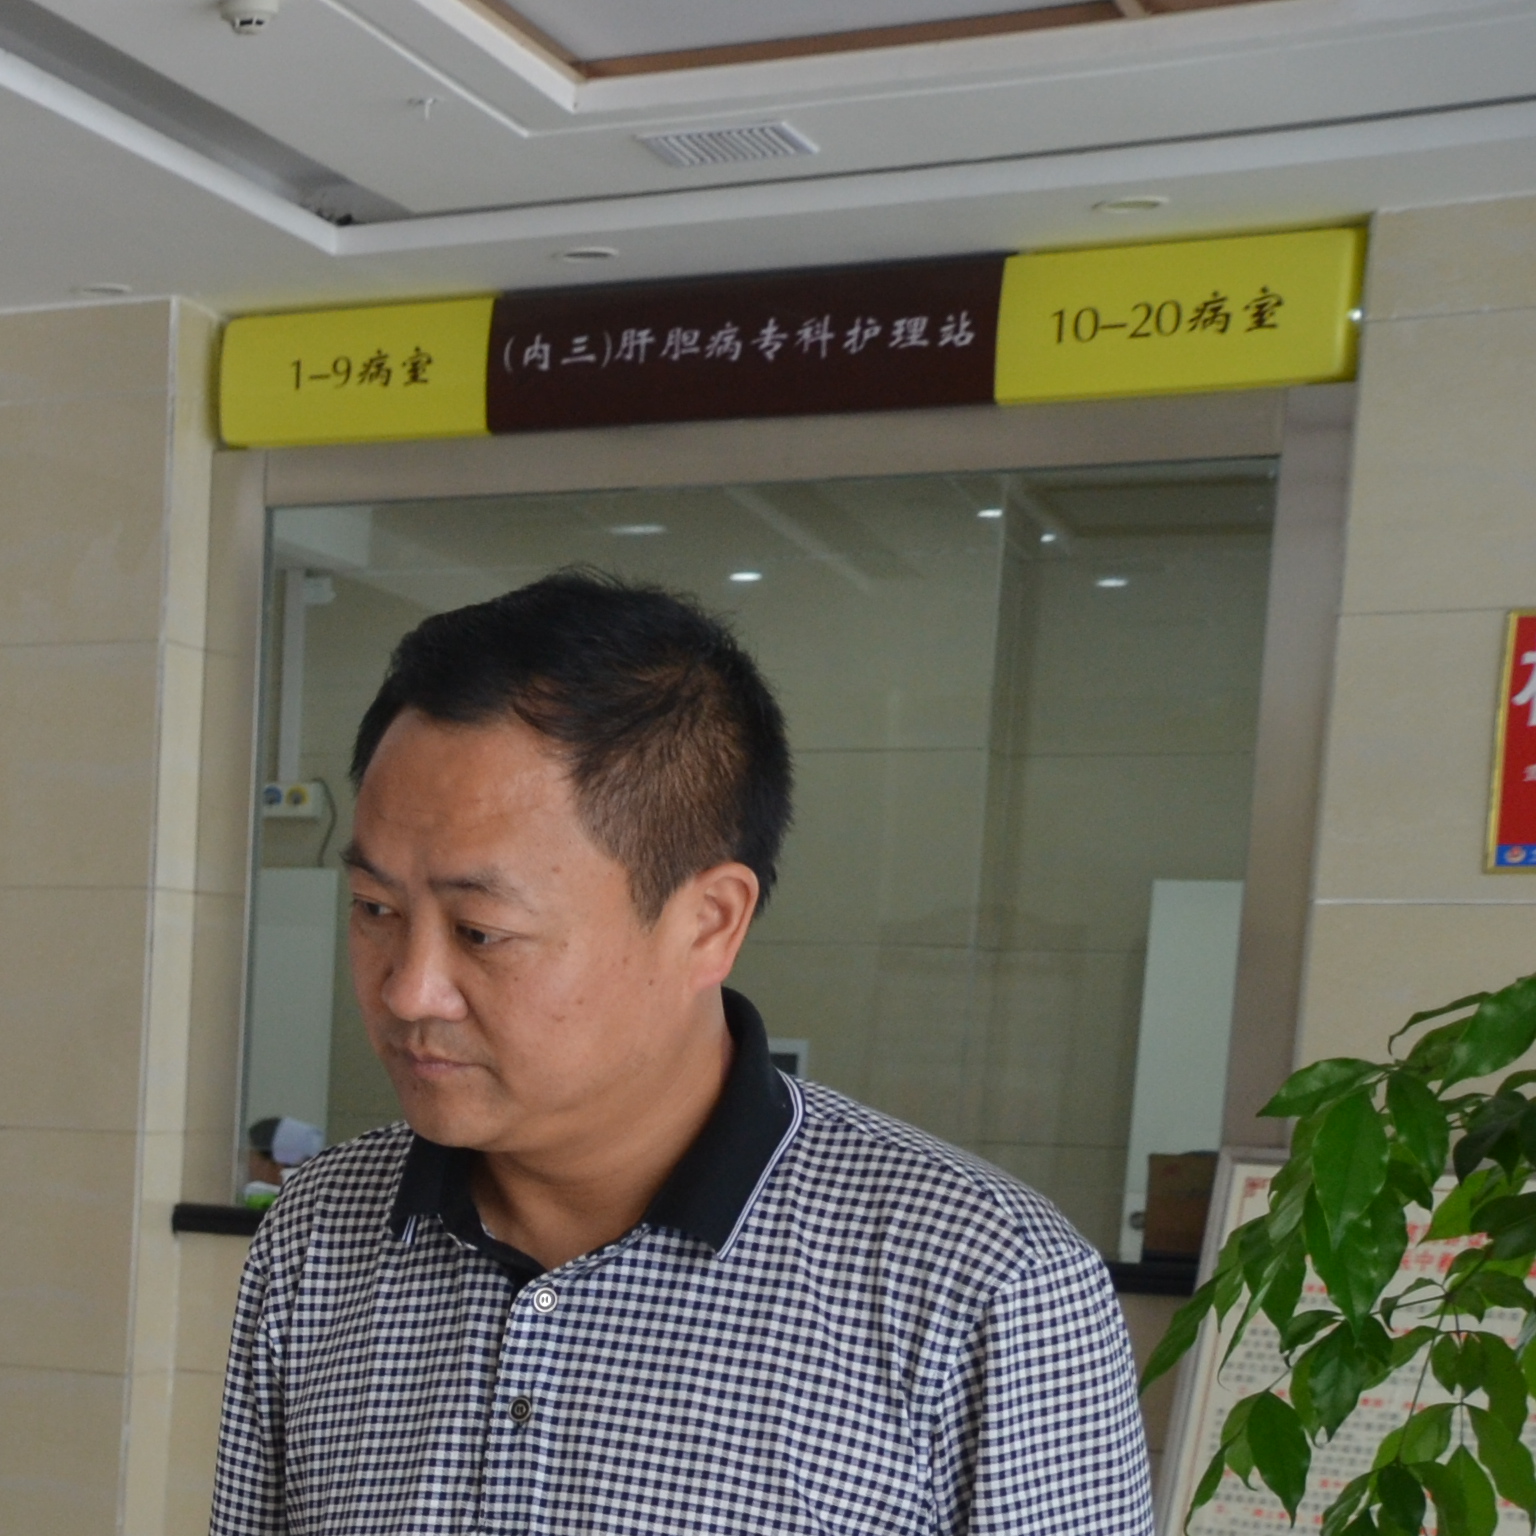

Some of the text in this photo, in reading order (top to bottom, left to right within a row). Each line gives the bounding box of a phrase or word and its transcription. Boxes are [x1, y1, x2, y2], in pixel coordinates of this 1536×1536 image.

[503, 310, 976, 373] (内三)肝胆病专科护理站
[1051, 286, 1284, 345] 10-20病室
[291, 346, 433, 391] 1-9病室
